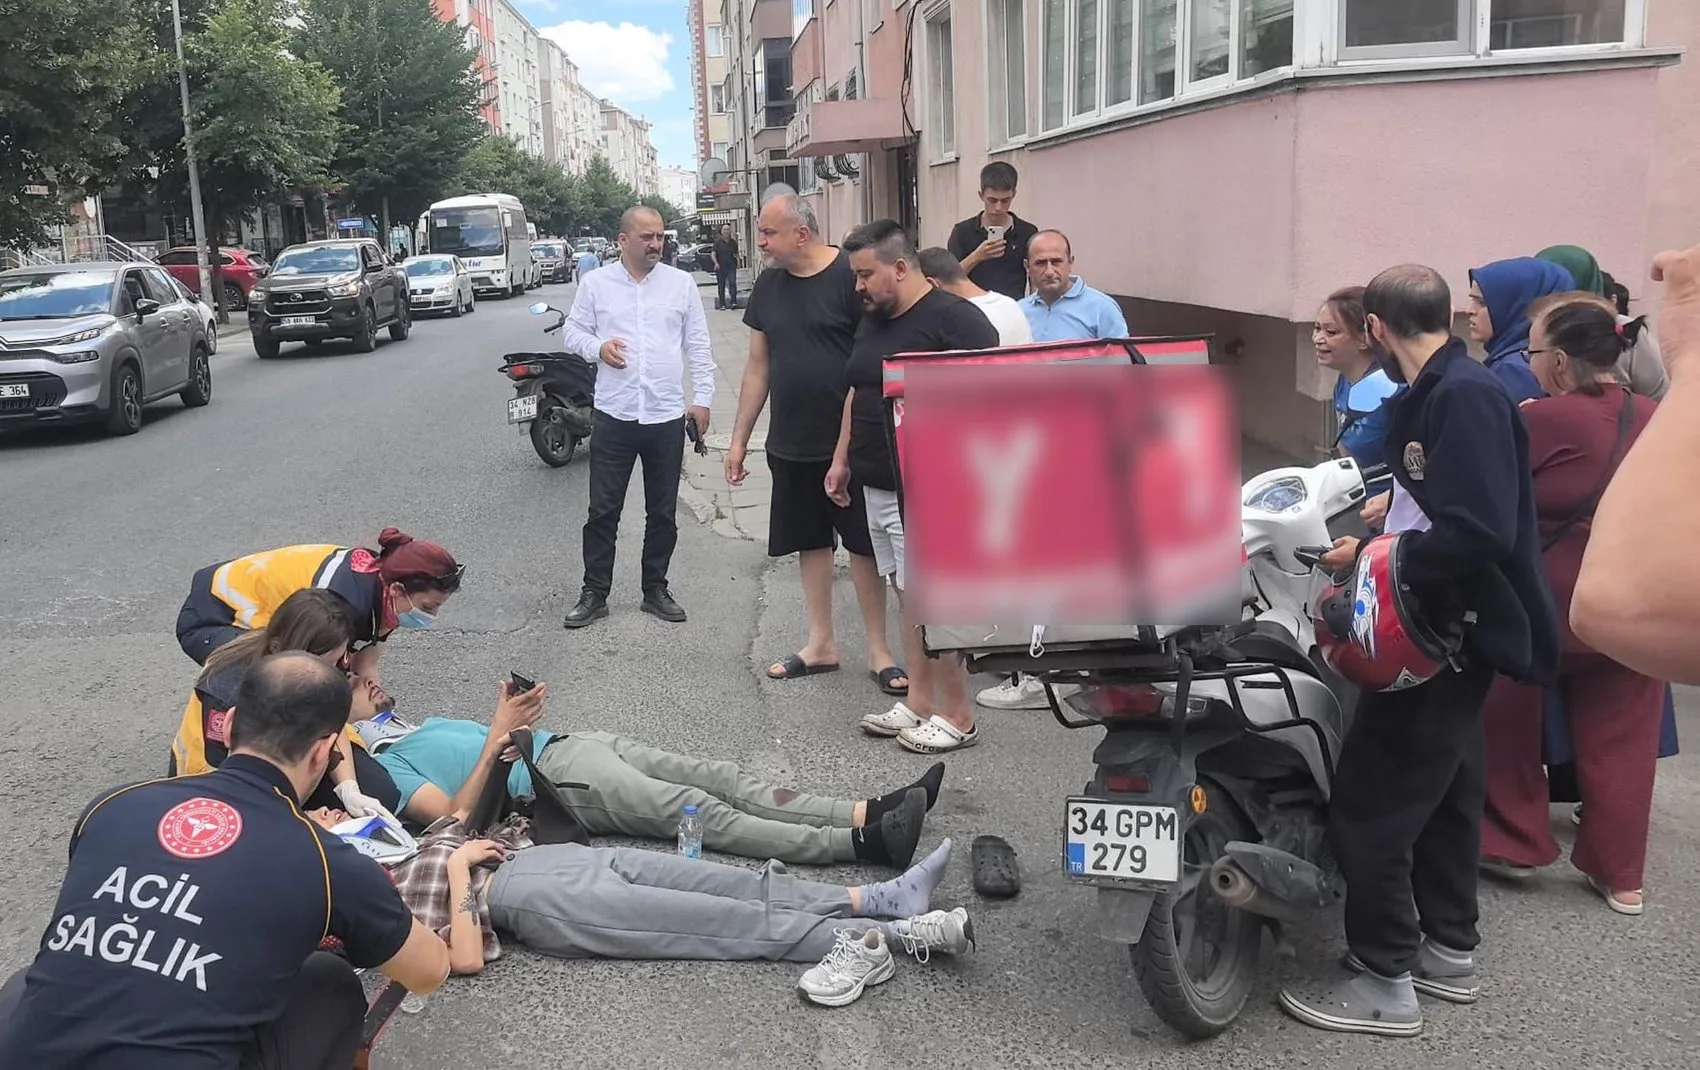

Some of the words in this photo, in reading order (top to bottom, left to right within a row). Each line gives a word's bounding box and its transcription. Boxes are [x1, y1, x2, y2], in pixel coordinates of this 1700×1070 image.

[9, 385, 27, 396] 364
[510, 401, 518, 409] 34
[1072, 806, 1108, 836] 34
[1115, 809, 1176, 841] GPM
[1070, 861, 1083, 872] TR
[1092, 842, 1147, 873] 279
[92, 866, 203, 925] ACİL
[48, 913, 223, 992] SAĞLIK
